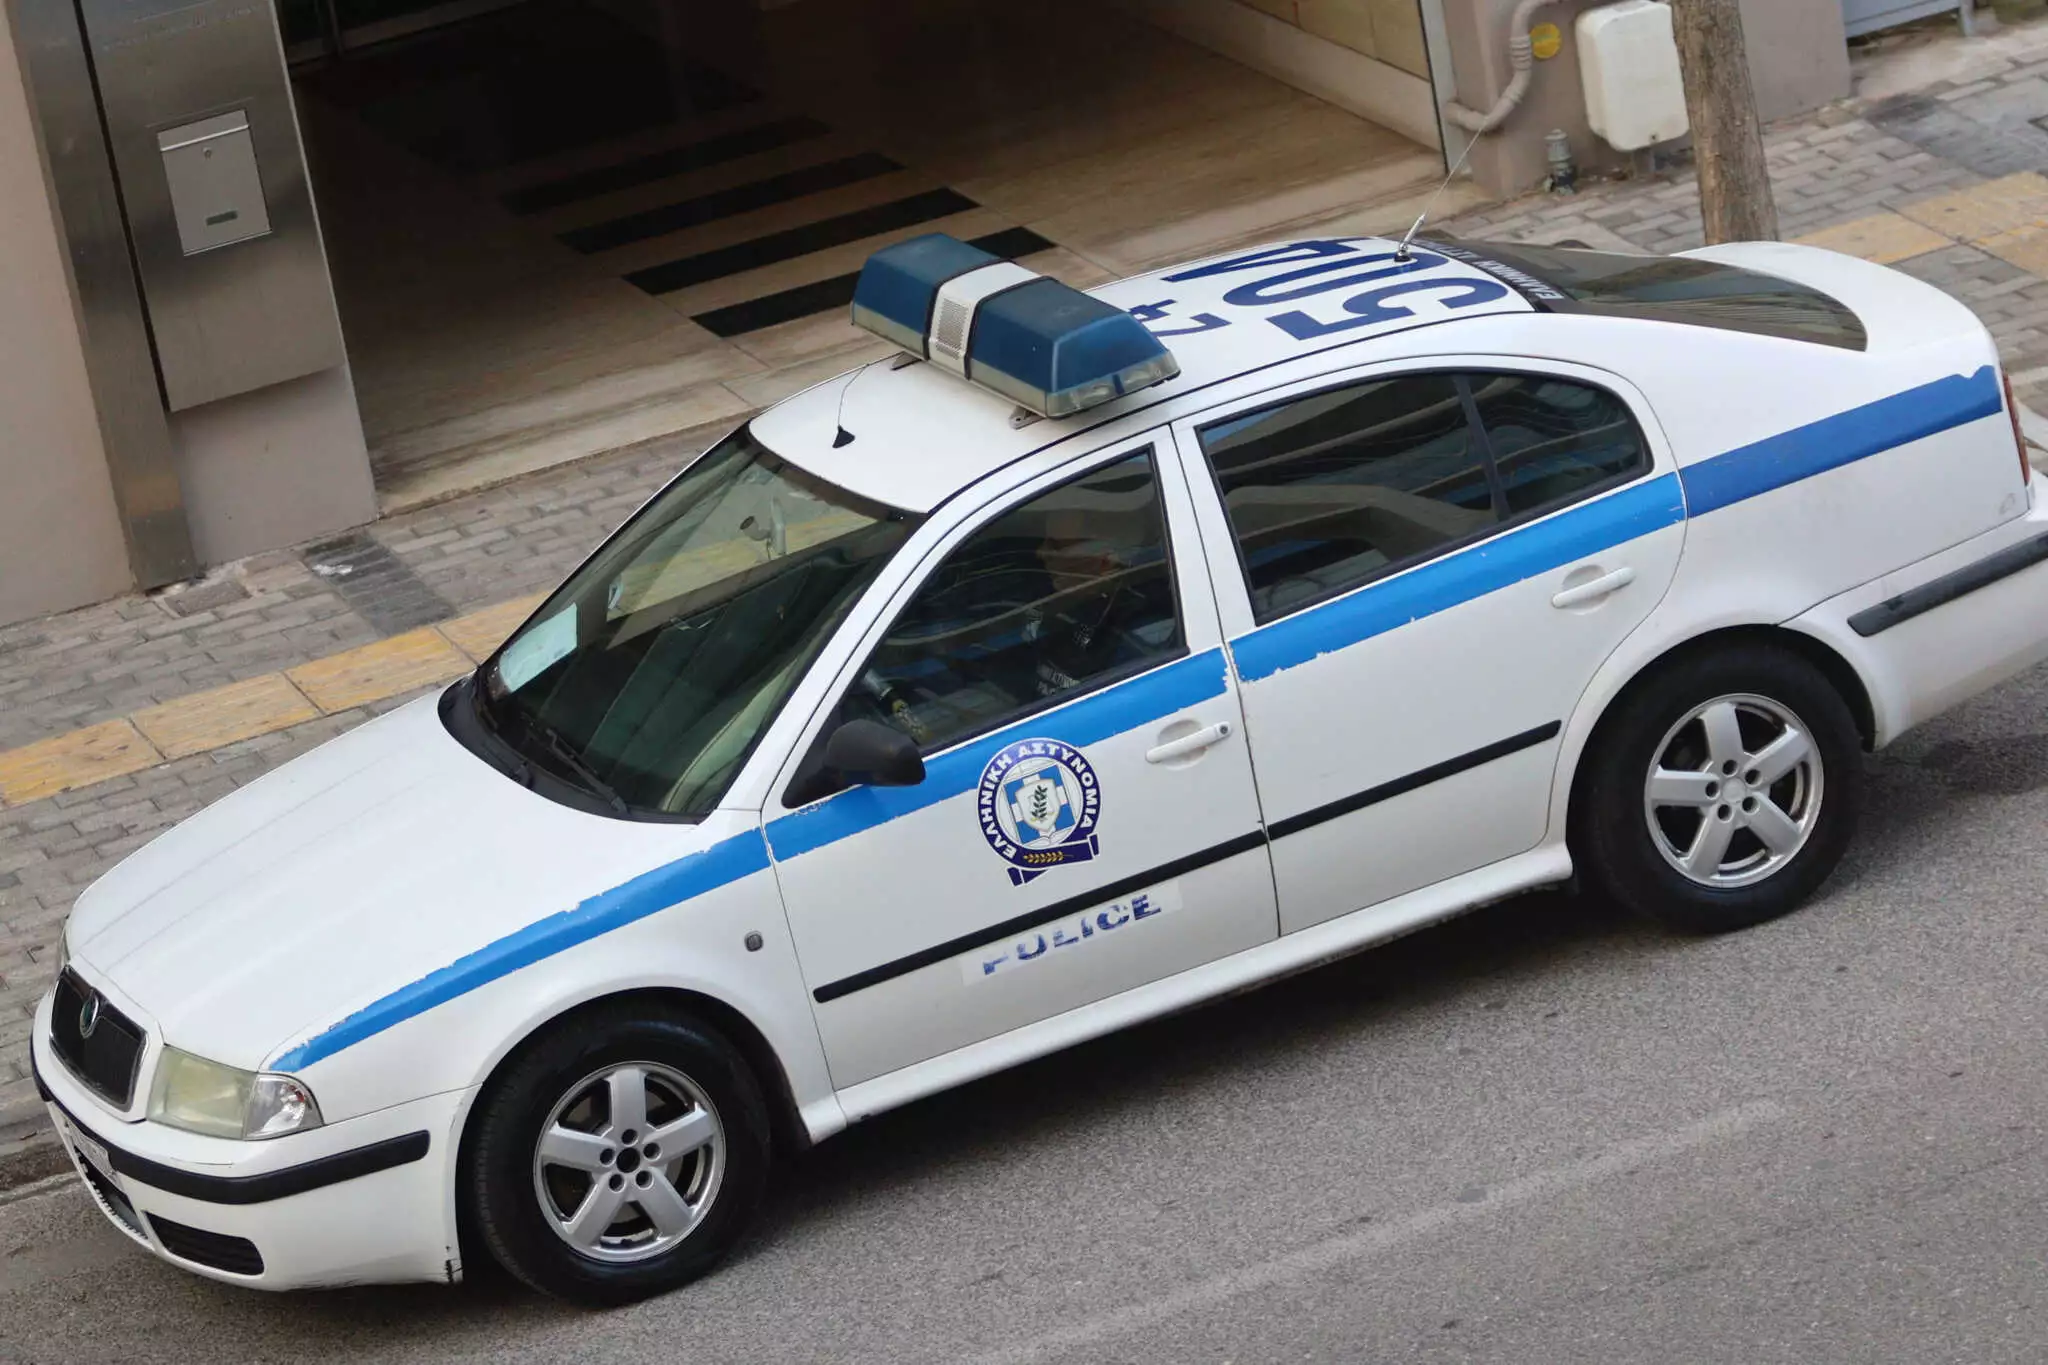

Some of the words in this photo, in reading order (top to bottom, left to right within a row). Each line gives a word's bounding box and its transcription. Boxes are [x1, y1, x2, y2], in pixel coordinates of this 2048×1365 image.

[1160, 237, 1508, 341] 504
[980, 753, 1017, 859] ΕΛΛΗΝΙΚΗ
[1018, 742, 1098, 829] ΑΣΤΥΝΟΜΙΑ
